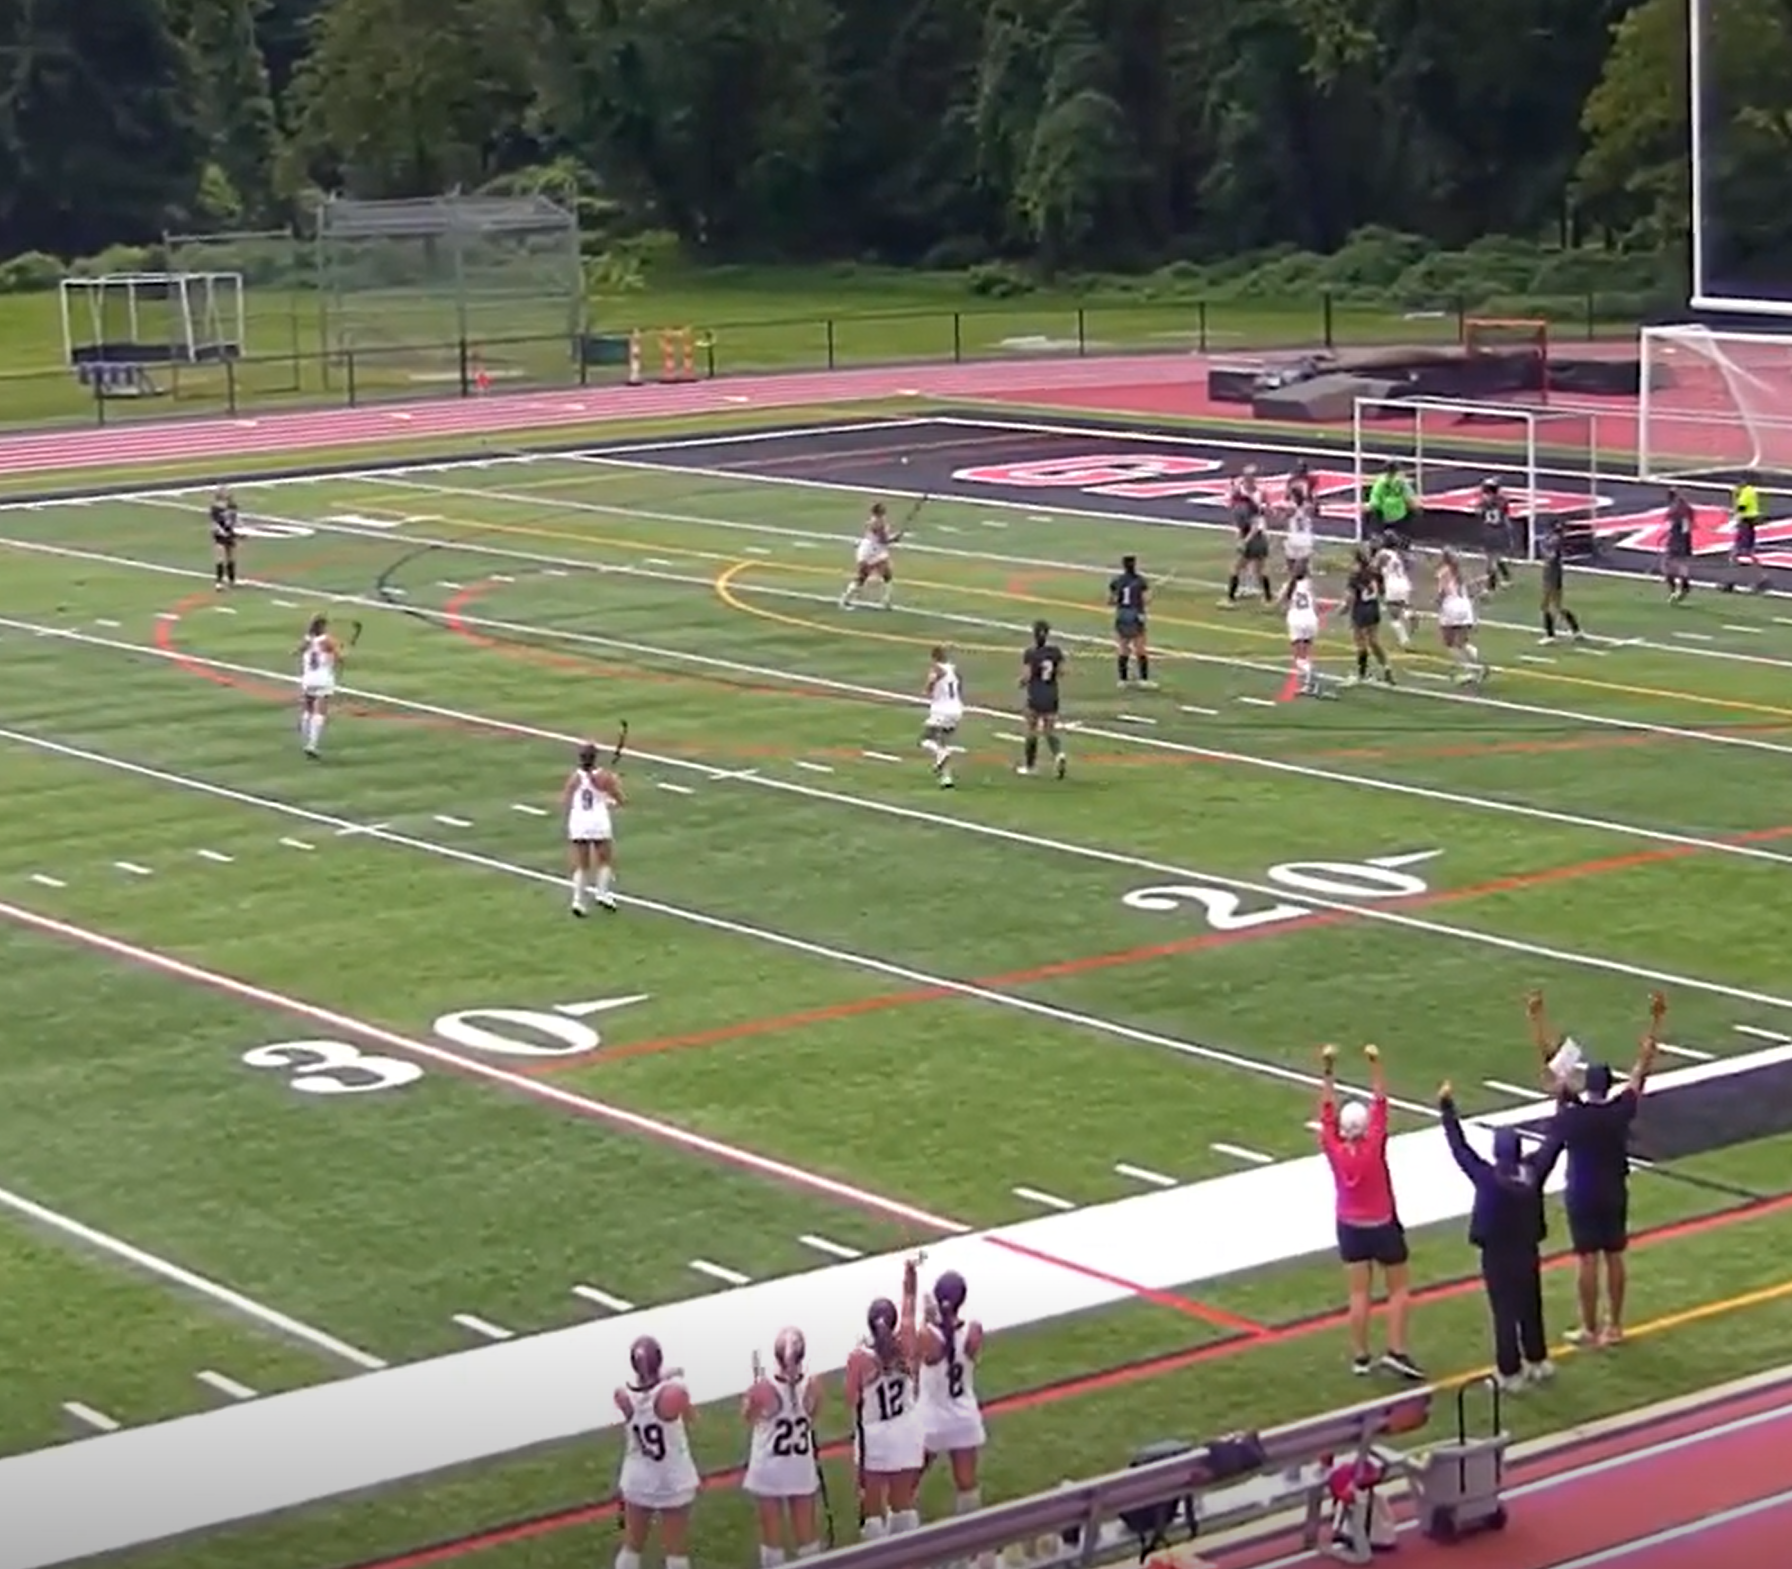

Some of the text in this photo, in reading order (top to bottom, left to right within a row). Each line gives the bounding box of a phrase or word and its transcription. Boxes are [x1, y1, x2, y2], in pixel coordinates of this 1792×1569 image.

[1122, 861, 1428, 930] 20
[242, 1008, 601, 1094] 30
[876, 1379, 904, 1421] 12
[632, 1423, 666, 1462] 19
[773, 1416, 810, 1456] 23
